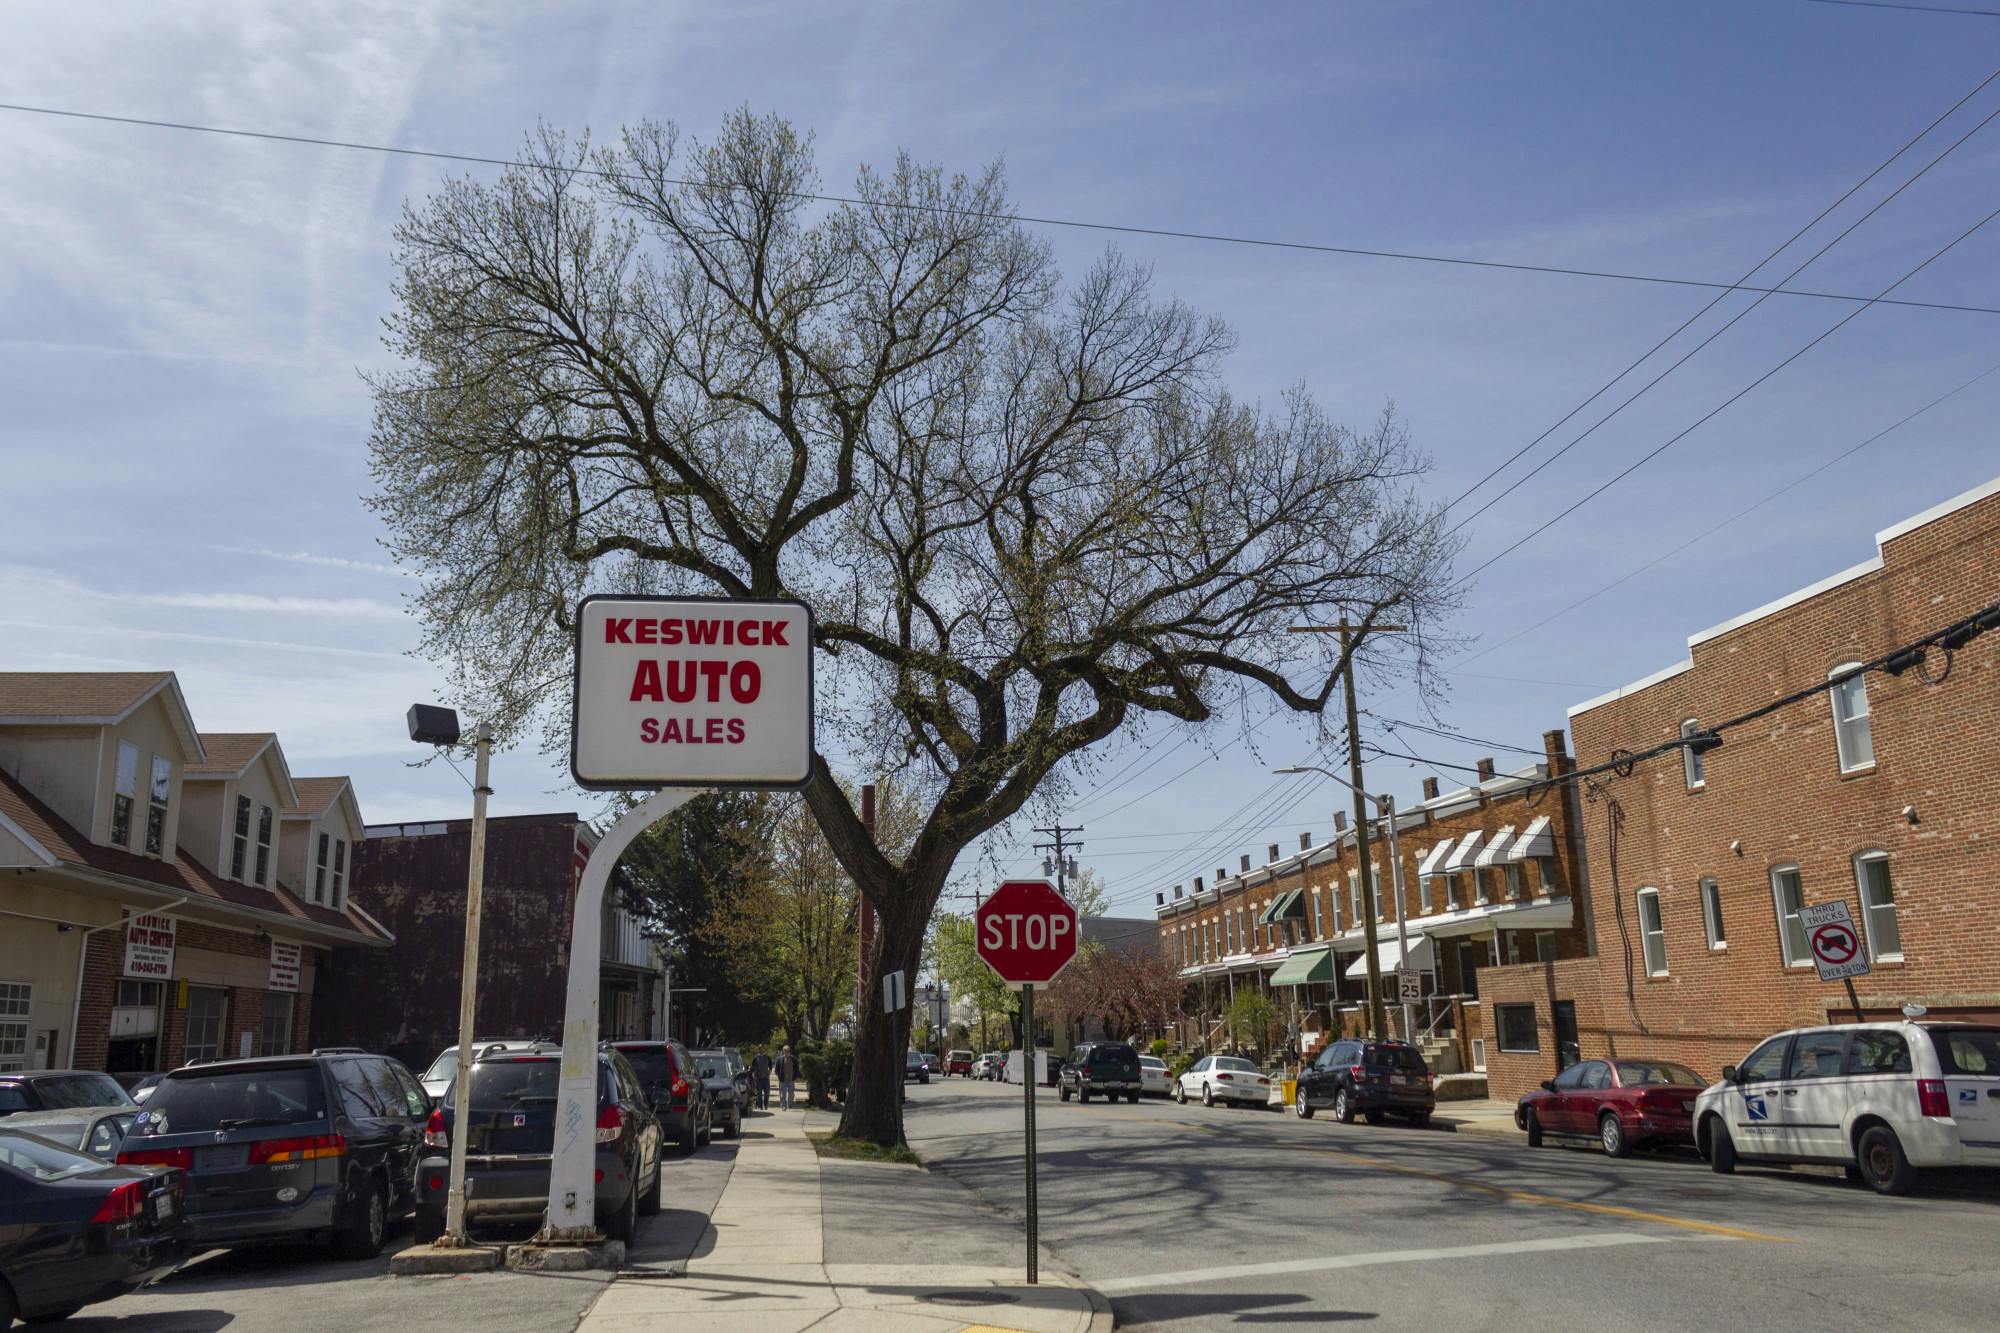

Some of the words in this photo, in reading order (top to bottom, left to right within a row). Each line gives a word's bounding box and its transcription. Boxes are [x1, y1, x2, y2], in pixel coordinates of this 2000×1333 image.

[605, 618, 790, 646] KESWICK
[629, 659, 762, 705] AUTO
[640, 717, 746, 744] SALES
[1808, 911, 1844, 925] TRUCKS
[1810, 904, 1835, 915] THRU
[129, 927, 149, 945] AUTO
[149, 930, 174, 949] CENTER
[983, 913, 1070, 951] STOP
[1821, 968, 1843, 978] OVER
[1852, 963, 1867, 973] TON
[1401, 984, 1419, 998] 25
